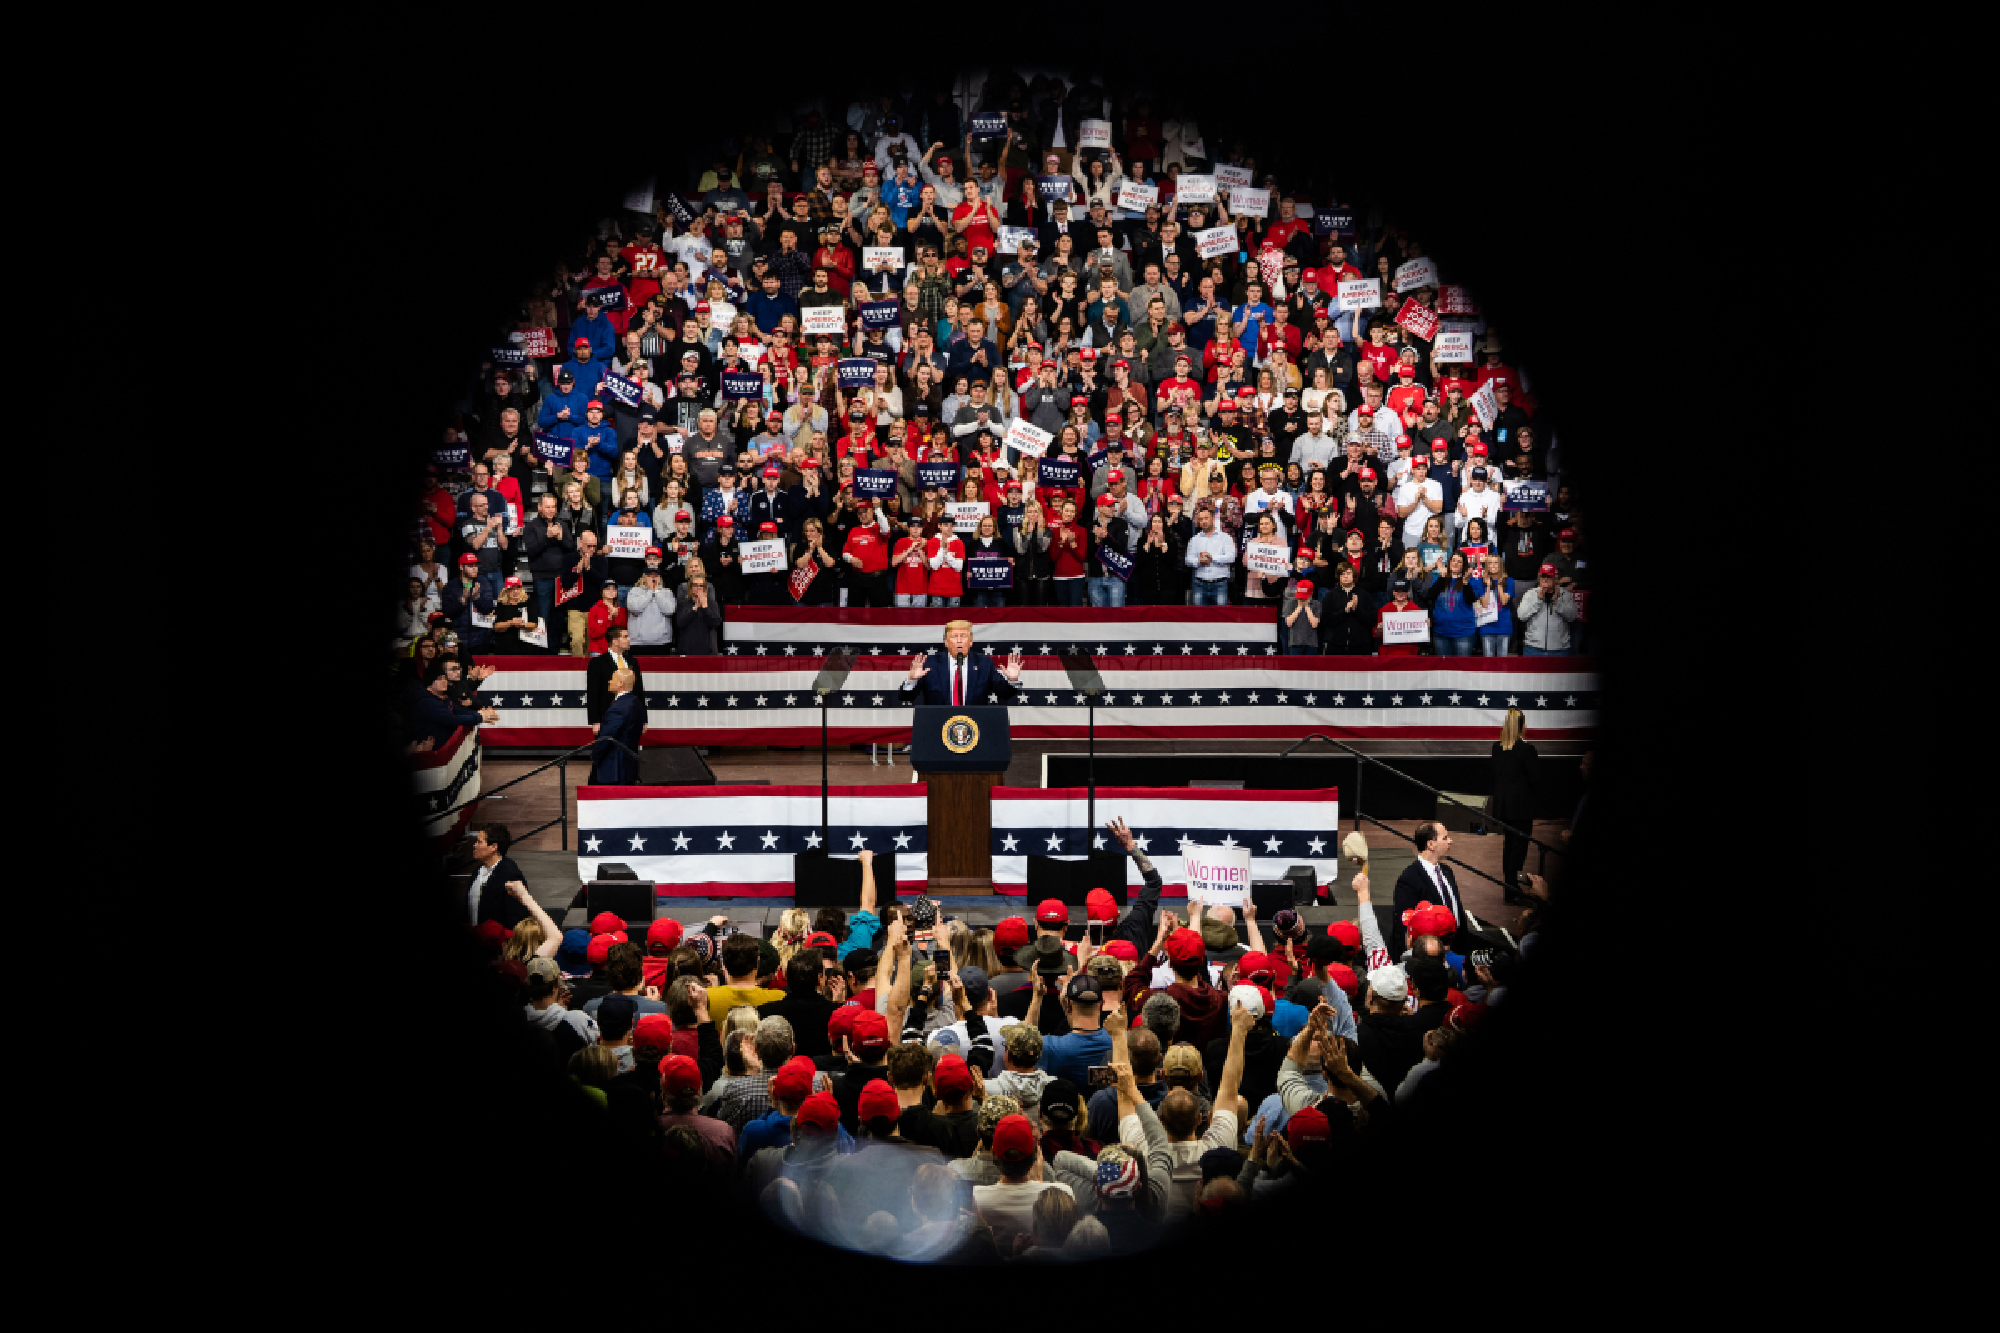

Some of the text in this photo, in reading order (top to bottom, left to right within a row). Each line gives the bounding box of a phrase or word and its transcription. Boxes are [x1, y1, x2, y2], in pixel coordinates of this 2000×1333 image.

[635, 253, 657, 270] 27
[1341, 289, 1377, 299] AMERICA
[862, 307, 898, 316] TRUMP
[840, 366, 875, 374] TRUMP
[724, 379, 761, 387] TRUMP
[536, 438, 570, 453] TRUMP
[1041, 465, 1077, 474] TRUMP
[857, 476, 894, 484] TRUMP
[609, 537, 649, 547] AMERICA
[752, 544, 772, 552] KEEP
[1258, 547, 1277, 556] KEEP
[743, 549, 784, 562] AMERICA
[1249, 553, 1285, 565] AMERICA
[1386, 619, 1426, 631] Women
[1186, 858, 1248, 882] Women
[1192, 880, 1245, 891] FOR TRUMP
